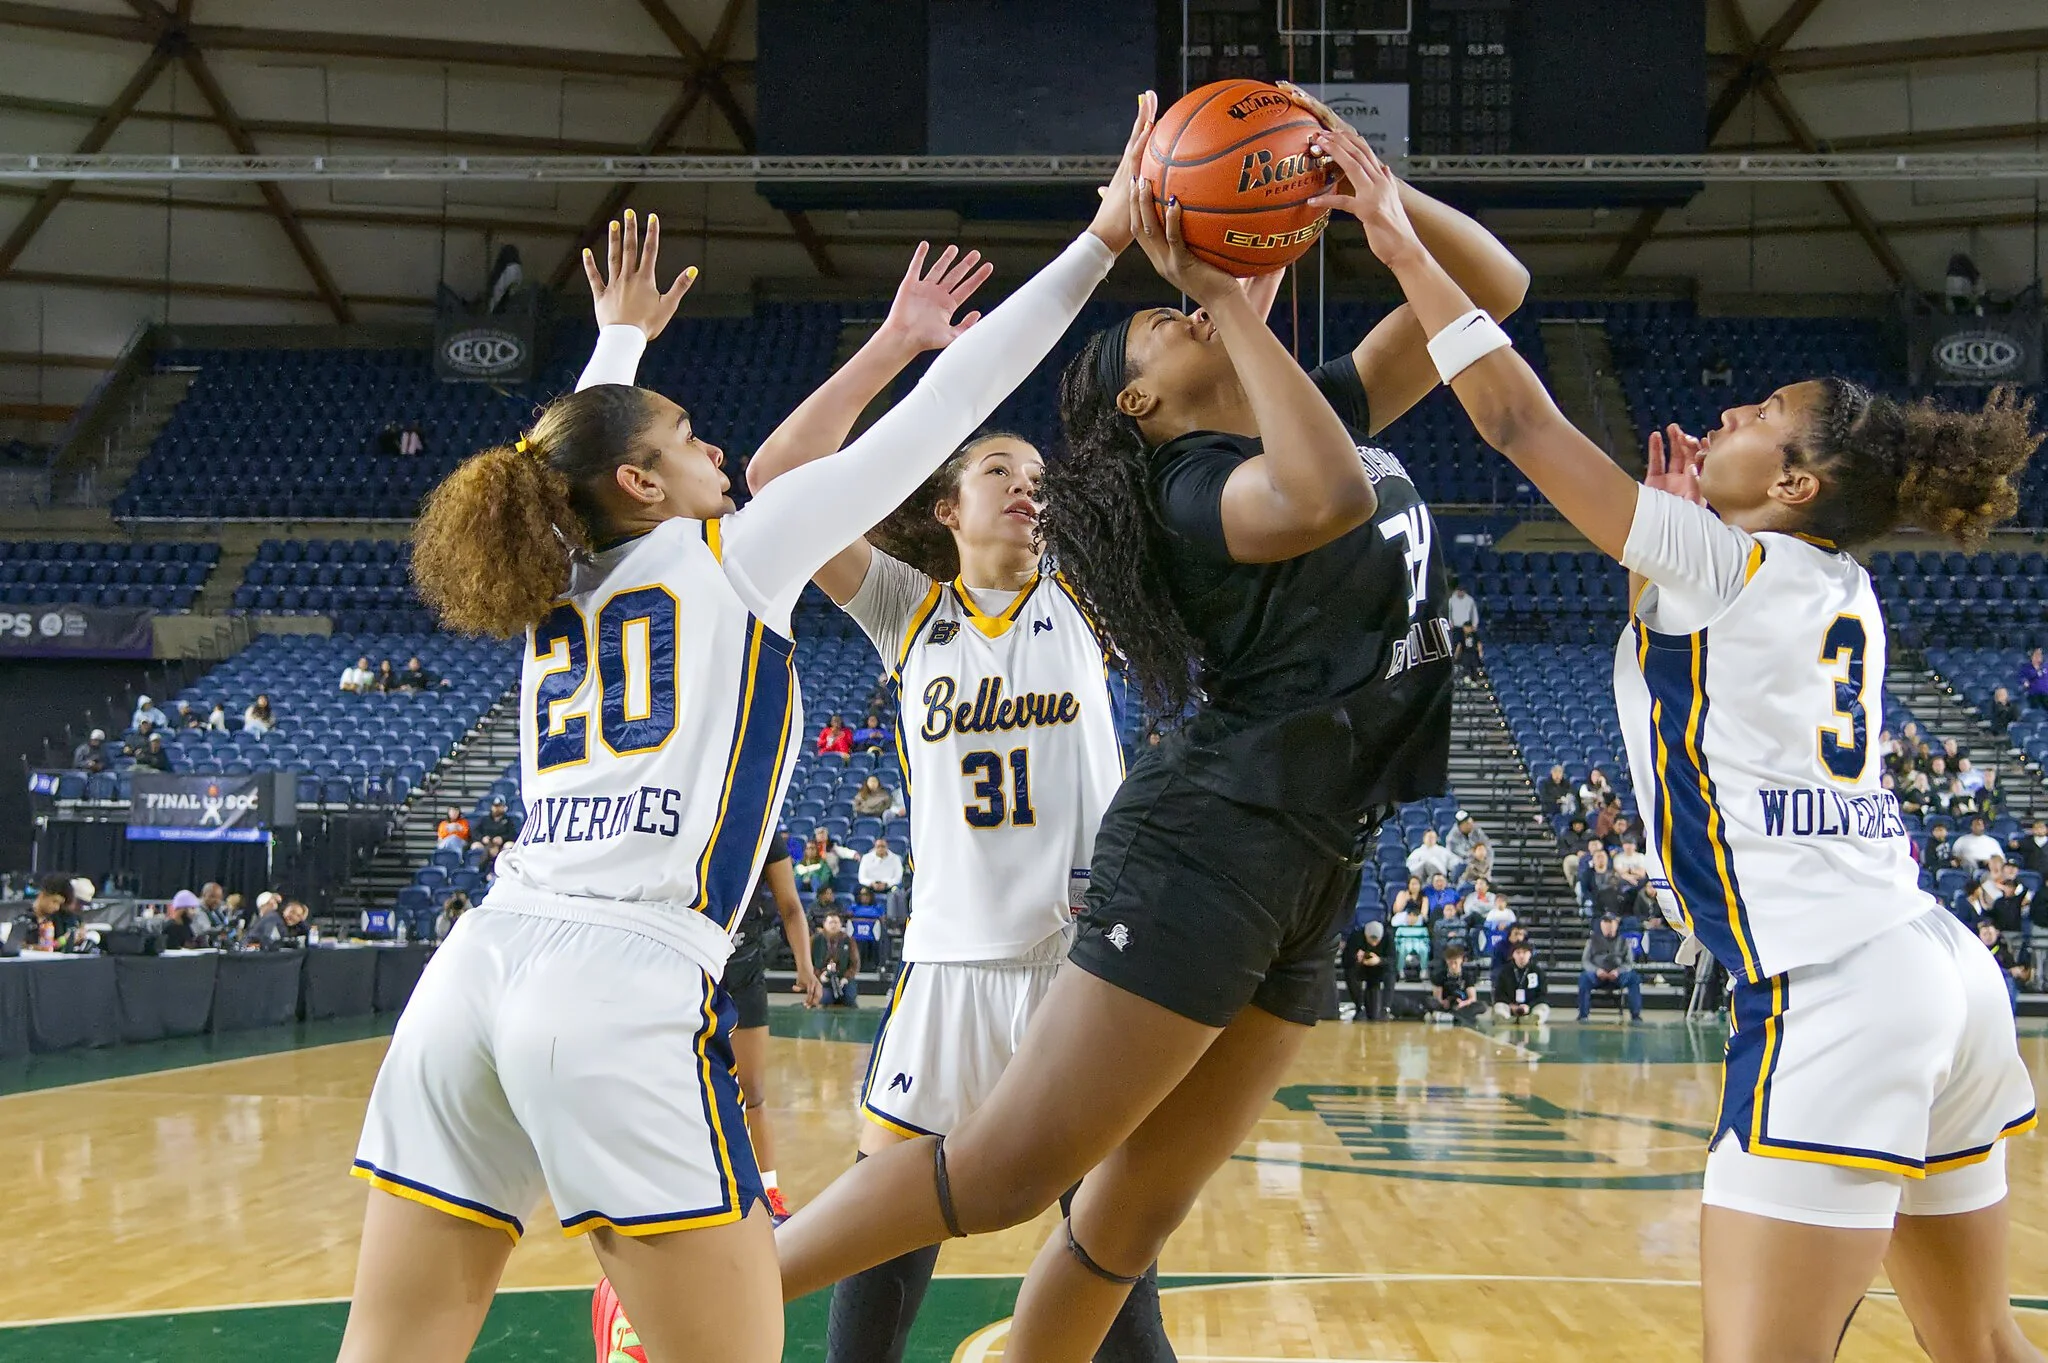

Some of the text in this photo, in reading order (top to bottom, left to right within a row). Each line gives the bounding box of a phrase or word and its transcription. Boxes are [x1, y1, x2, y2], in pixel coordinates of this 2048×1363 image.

[1233, 95, 1286, 116] WIAA
[1332, 106, 1380, 116] COMA
[1238, 134, 1326, 193] Bad
[534, 583, 681, 776] 20
[1816, 613, 1869, 784] 3
[921, 676, 1081, 743] Bellevue
[146, 793, 200, 809] FINAL
[523, 786, 682, 846] OLVERINES
[960, 747, 1037, 830] 31
[1759, 788, 1905, 839] WOLVERES
